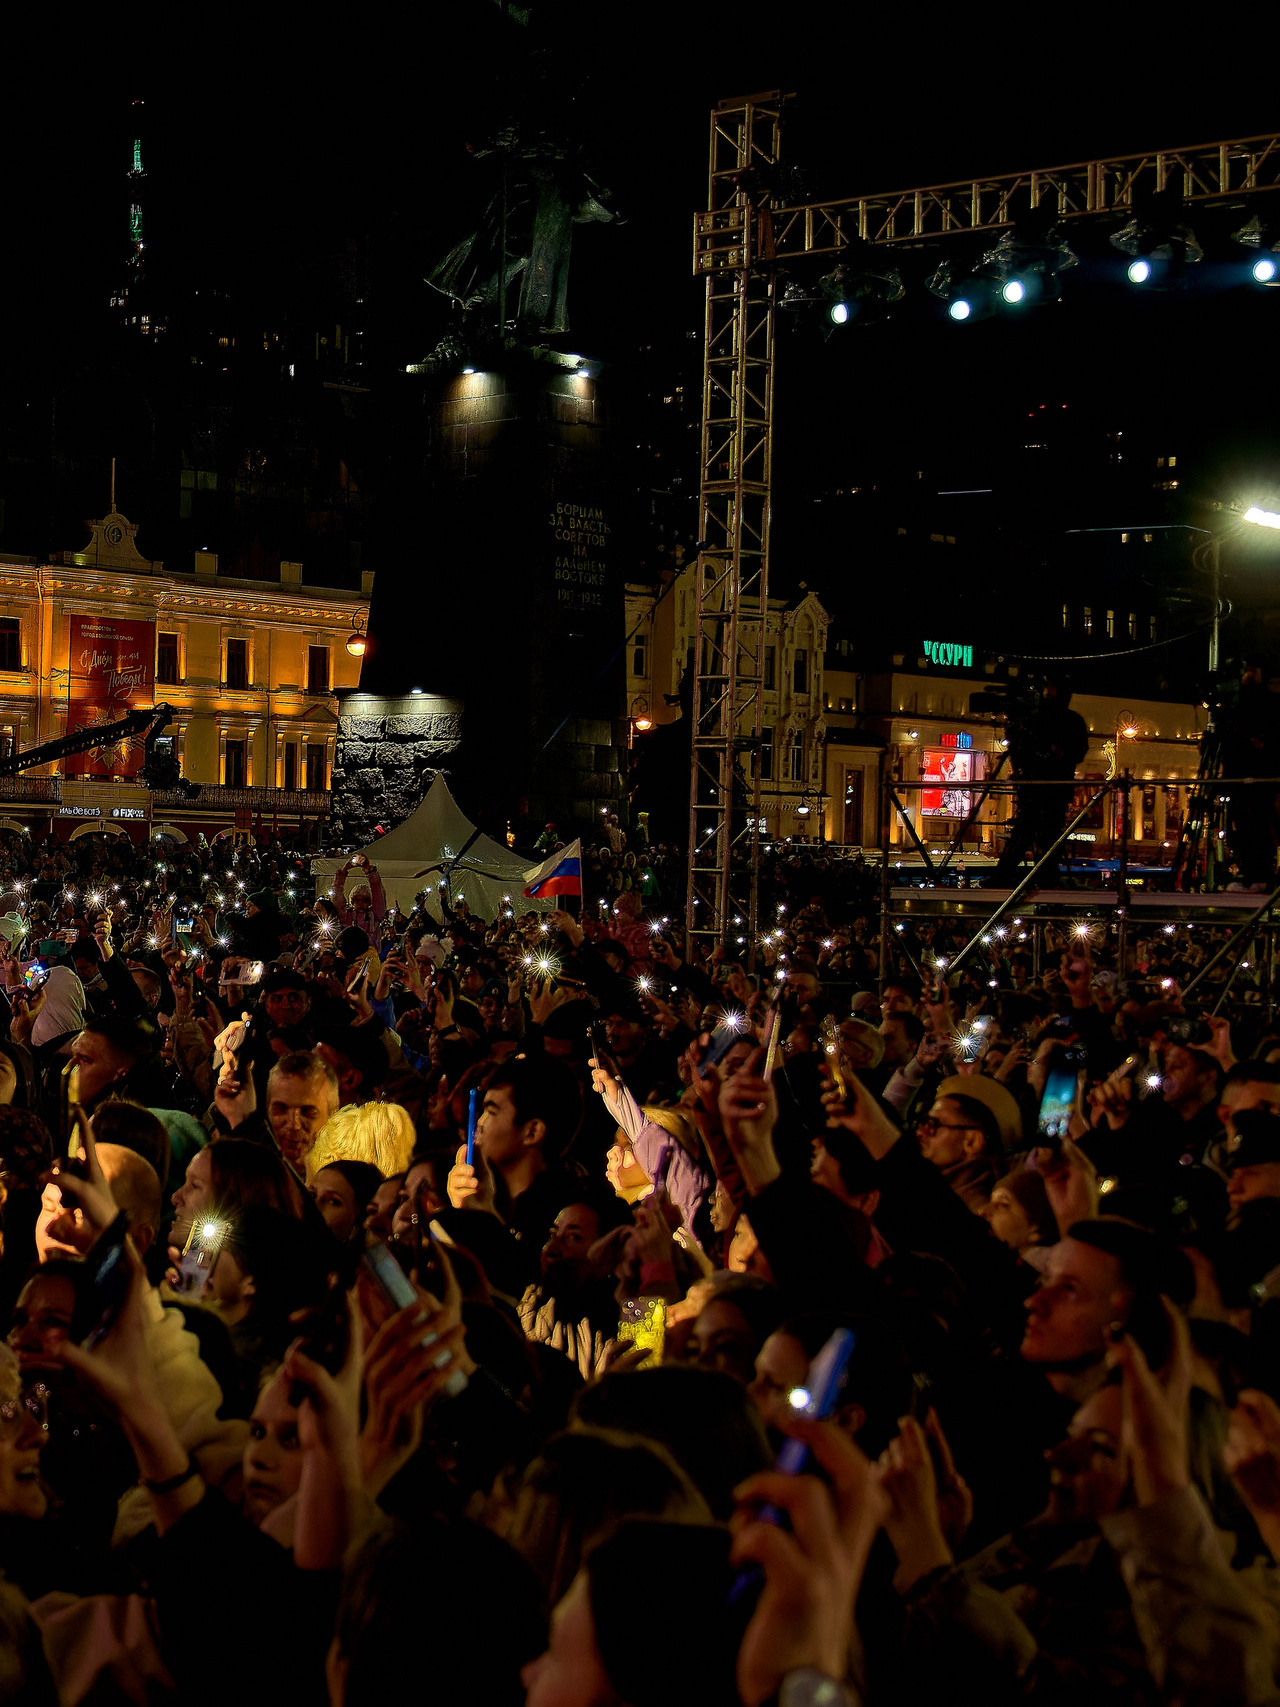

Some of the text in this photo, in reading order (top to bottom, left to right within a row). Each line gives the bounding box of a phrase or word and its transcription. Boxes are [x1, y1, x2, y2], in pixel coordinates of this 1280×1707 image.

[556, 502, 604, 520] БОРЦАМ
[548, 513, 612, 535] ЗА ВЛАСТЬ
[554, 528, 606, 547] СОВЕТОВ
[573, 544, 588, 557] НА
[555, 555, 606, 574] ДАЛЬНЕМ
[555, 569, 606, 586] ВОСТОКЕ
[923, 640, 973, 667] УССУРИ
